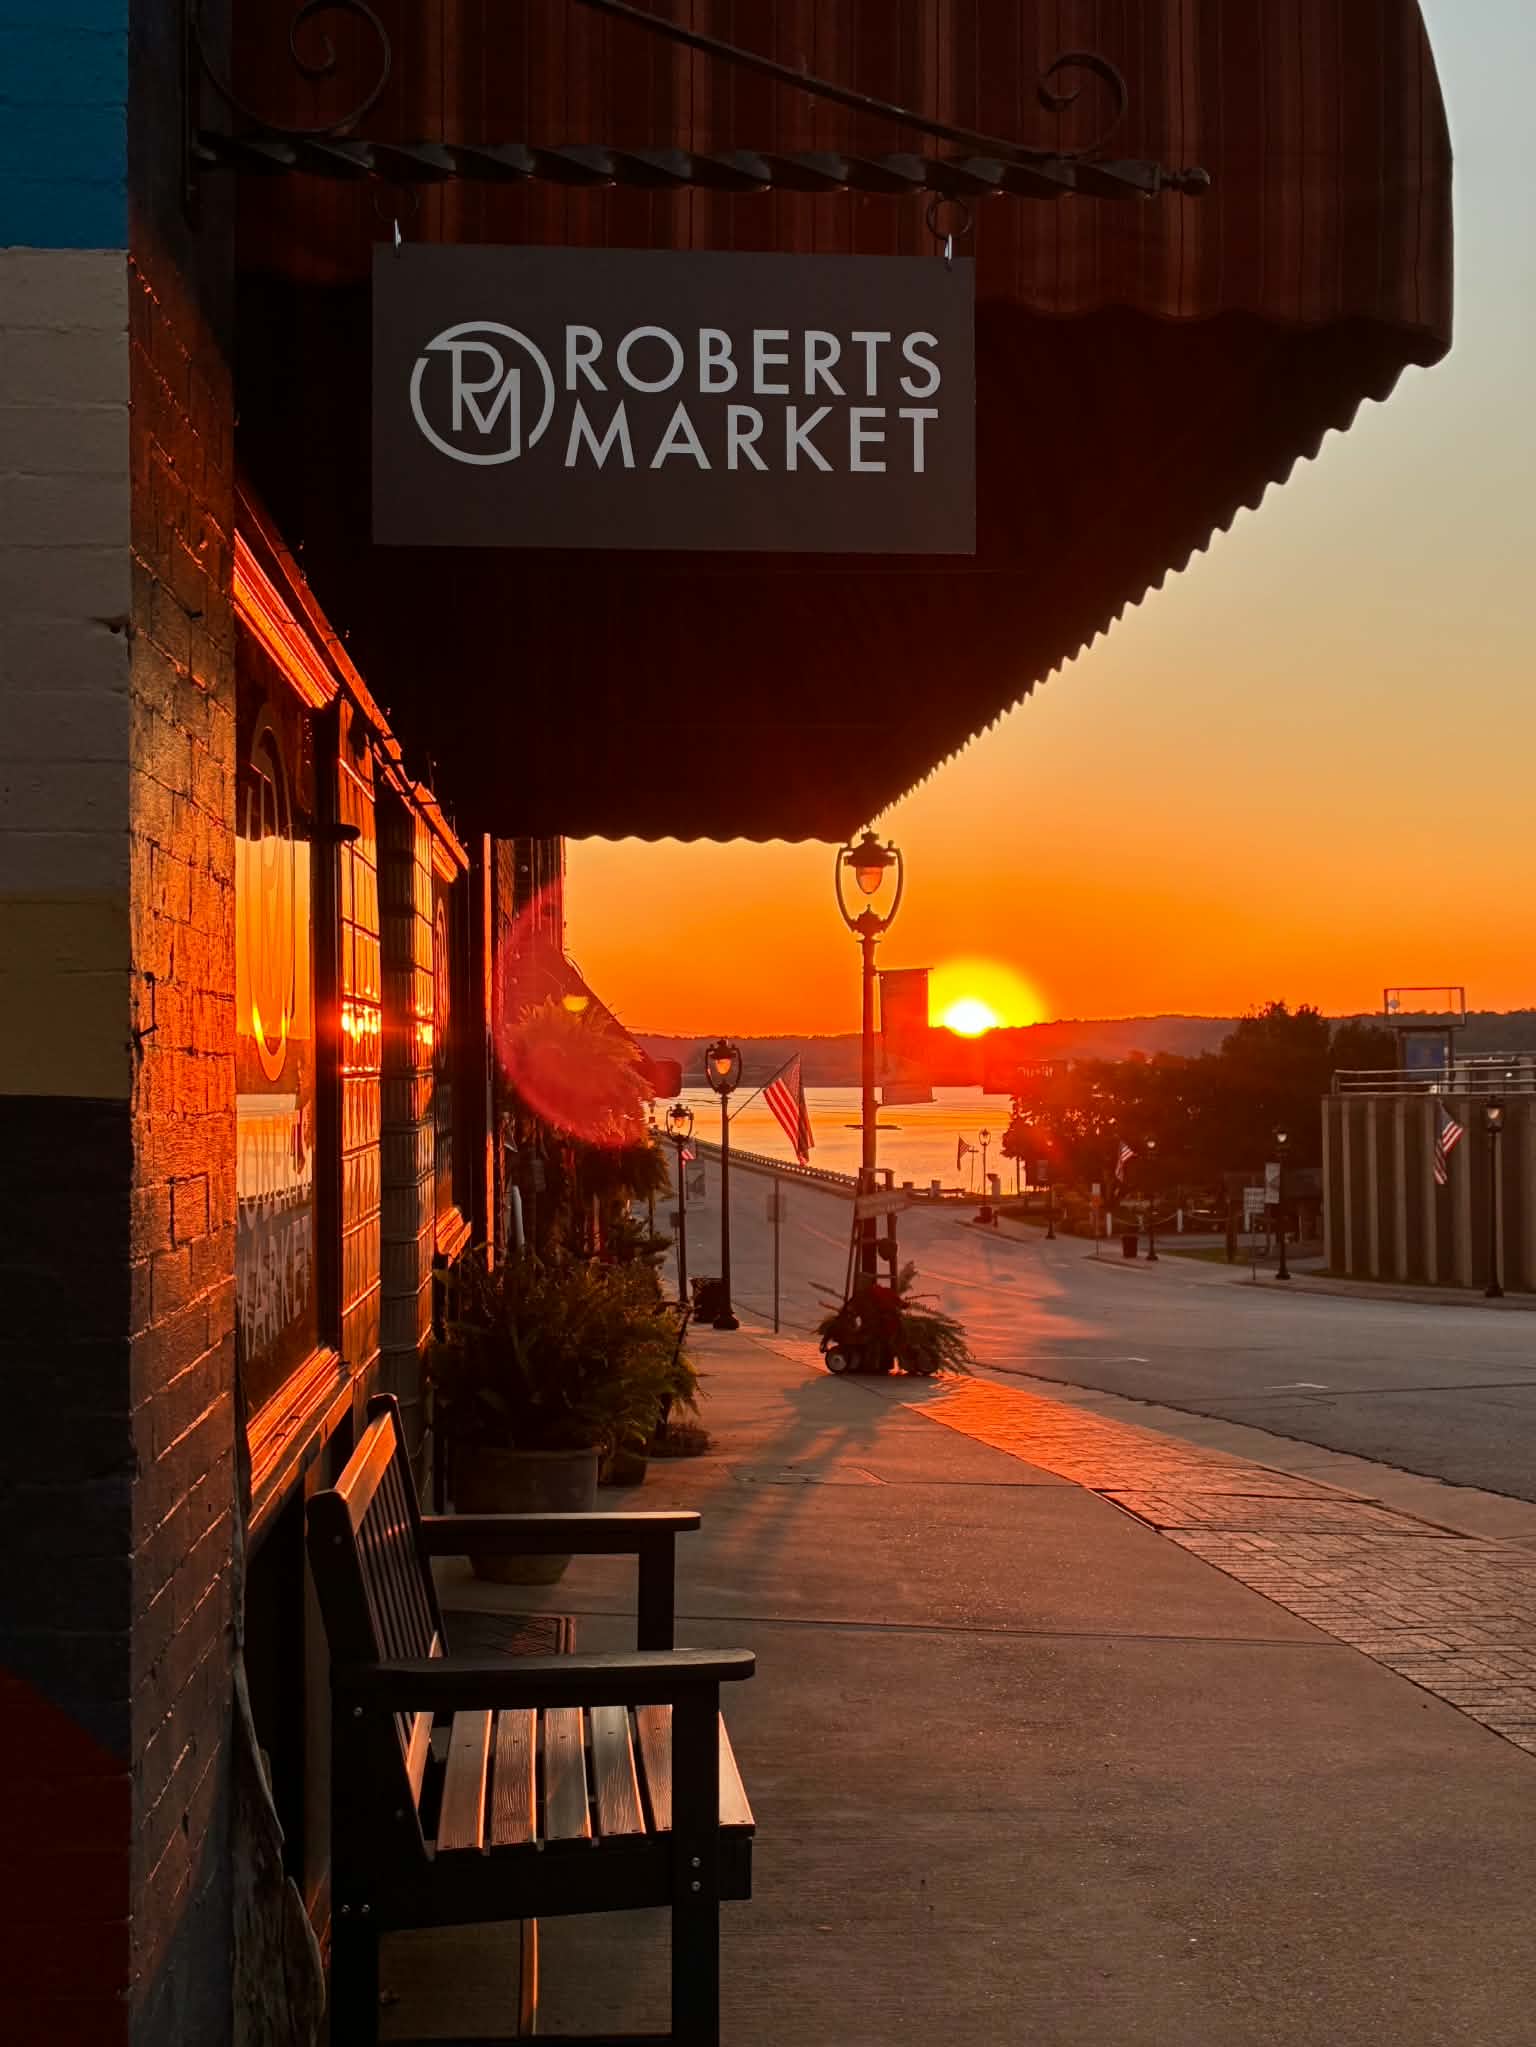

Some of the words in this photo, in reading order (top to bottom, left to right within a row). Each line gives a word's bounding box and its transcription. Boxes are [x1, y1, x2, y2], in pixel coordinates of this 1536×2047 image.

[566, 326, 941, 398] ROBERTS
[565, 400, 939, 472] MARKET
[236, 1106, 308, 1234] OBERTS
